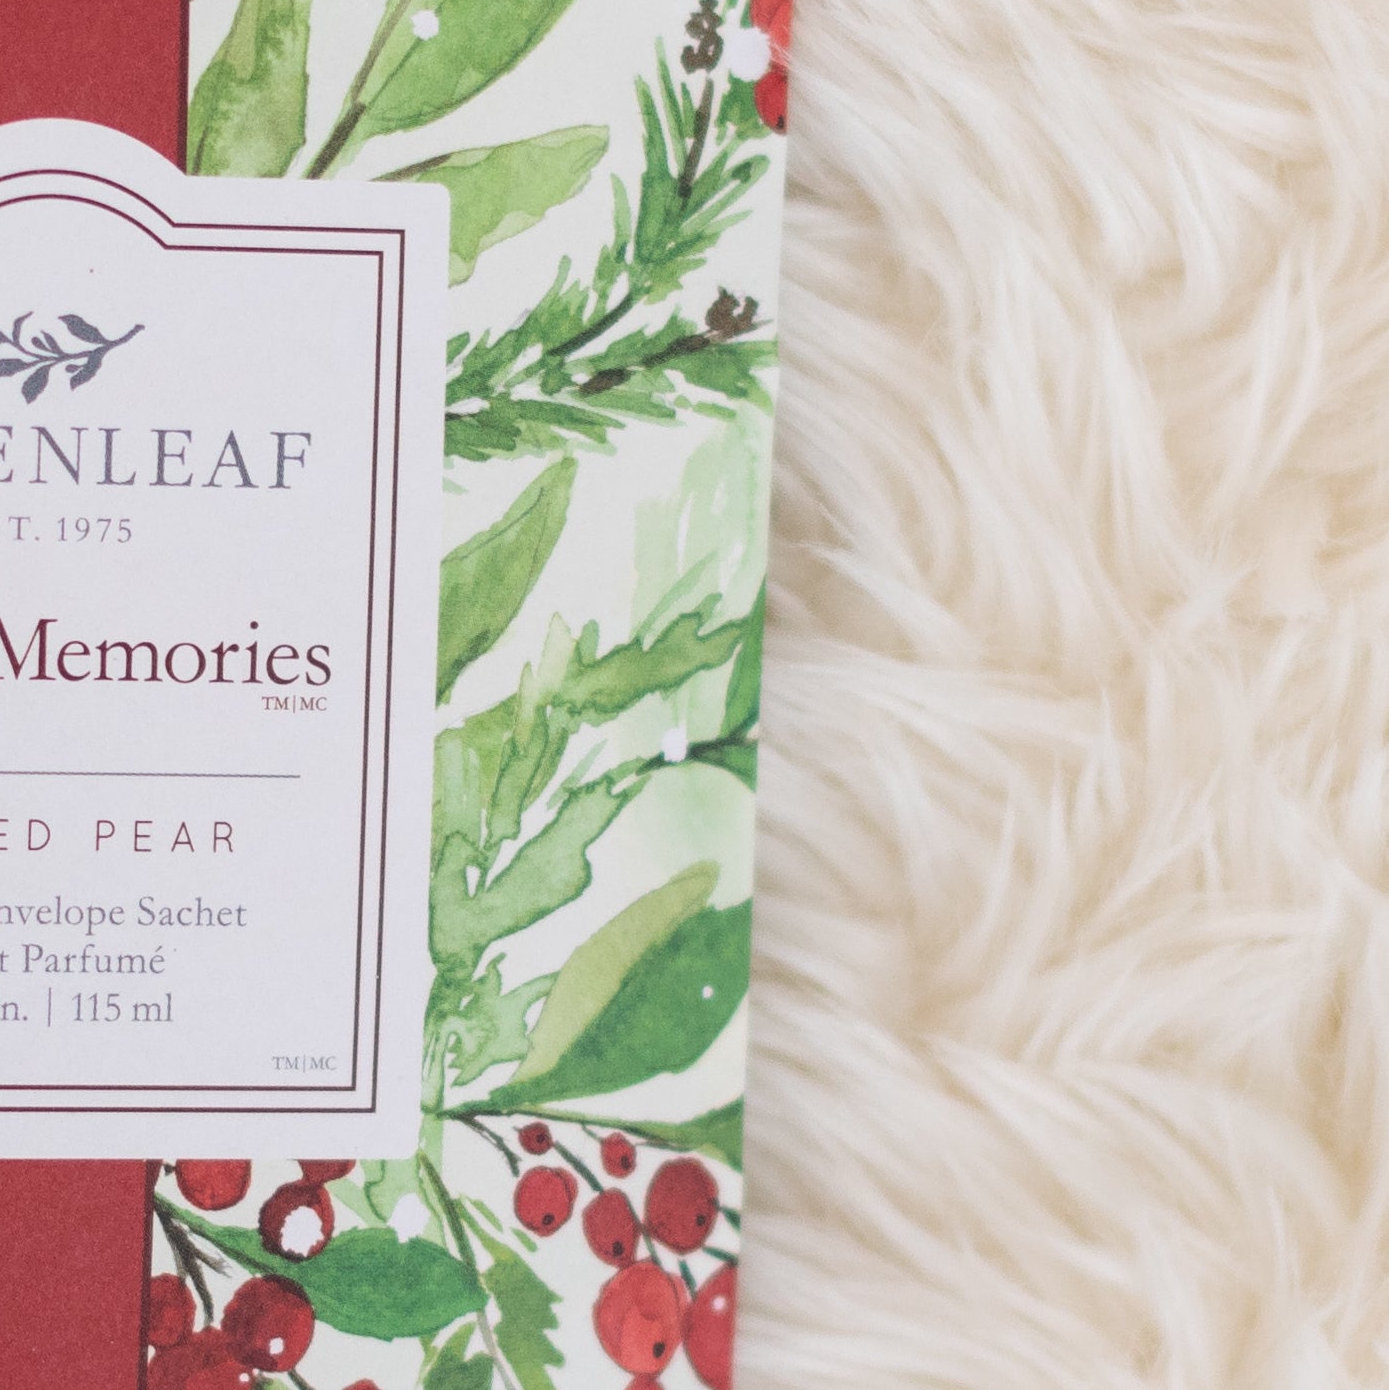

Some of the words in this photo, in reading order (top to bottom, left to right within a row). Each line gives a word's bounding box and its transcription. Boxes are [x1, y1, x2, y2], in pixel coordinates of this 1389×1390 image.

[57, 516, 134, 545] 1975
[94, 818, 236, 854] PEAR
[136, 895, 248, 928] Sachet
[20, 943, 166, 976] Parfumé
[71, 991, 122, 1024] 115
[131, 991, 174, 1024] ml
